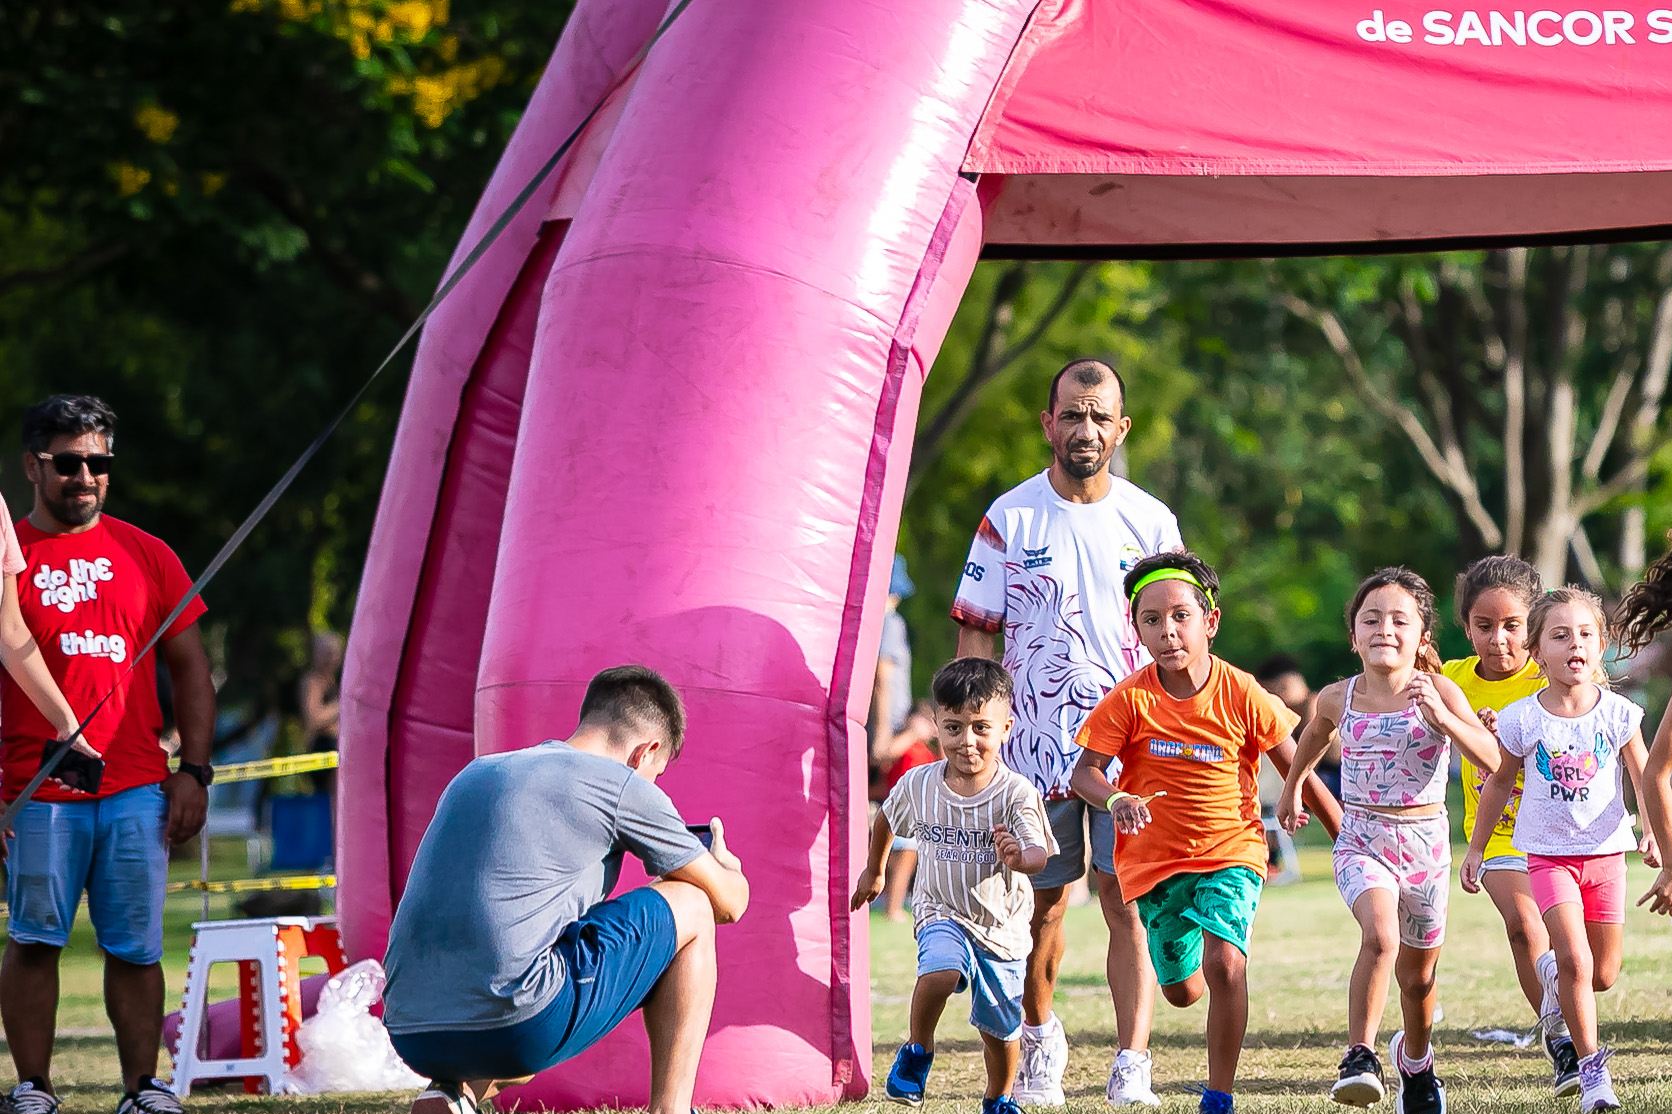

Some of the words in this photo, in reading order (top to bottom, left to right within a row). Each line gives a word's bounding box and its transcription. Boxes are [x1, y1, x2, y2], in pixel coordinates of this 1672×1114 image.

[1356, 9, 1413, 43] de
[1422, 9, 1636, 46] SANCOR
[34, 564, 68, 589] do
[41, 577, 97, 613] right
[60, 629, 126, 663] thing
[1552, 764, 1584, 781] GRL
[1551, 783, 1590, 801] PWR
[936, 849, 959, 861] FEAR
[961, 851, 976, 863] OF
